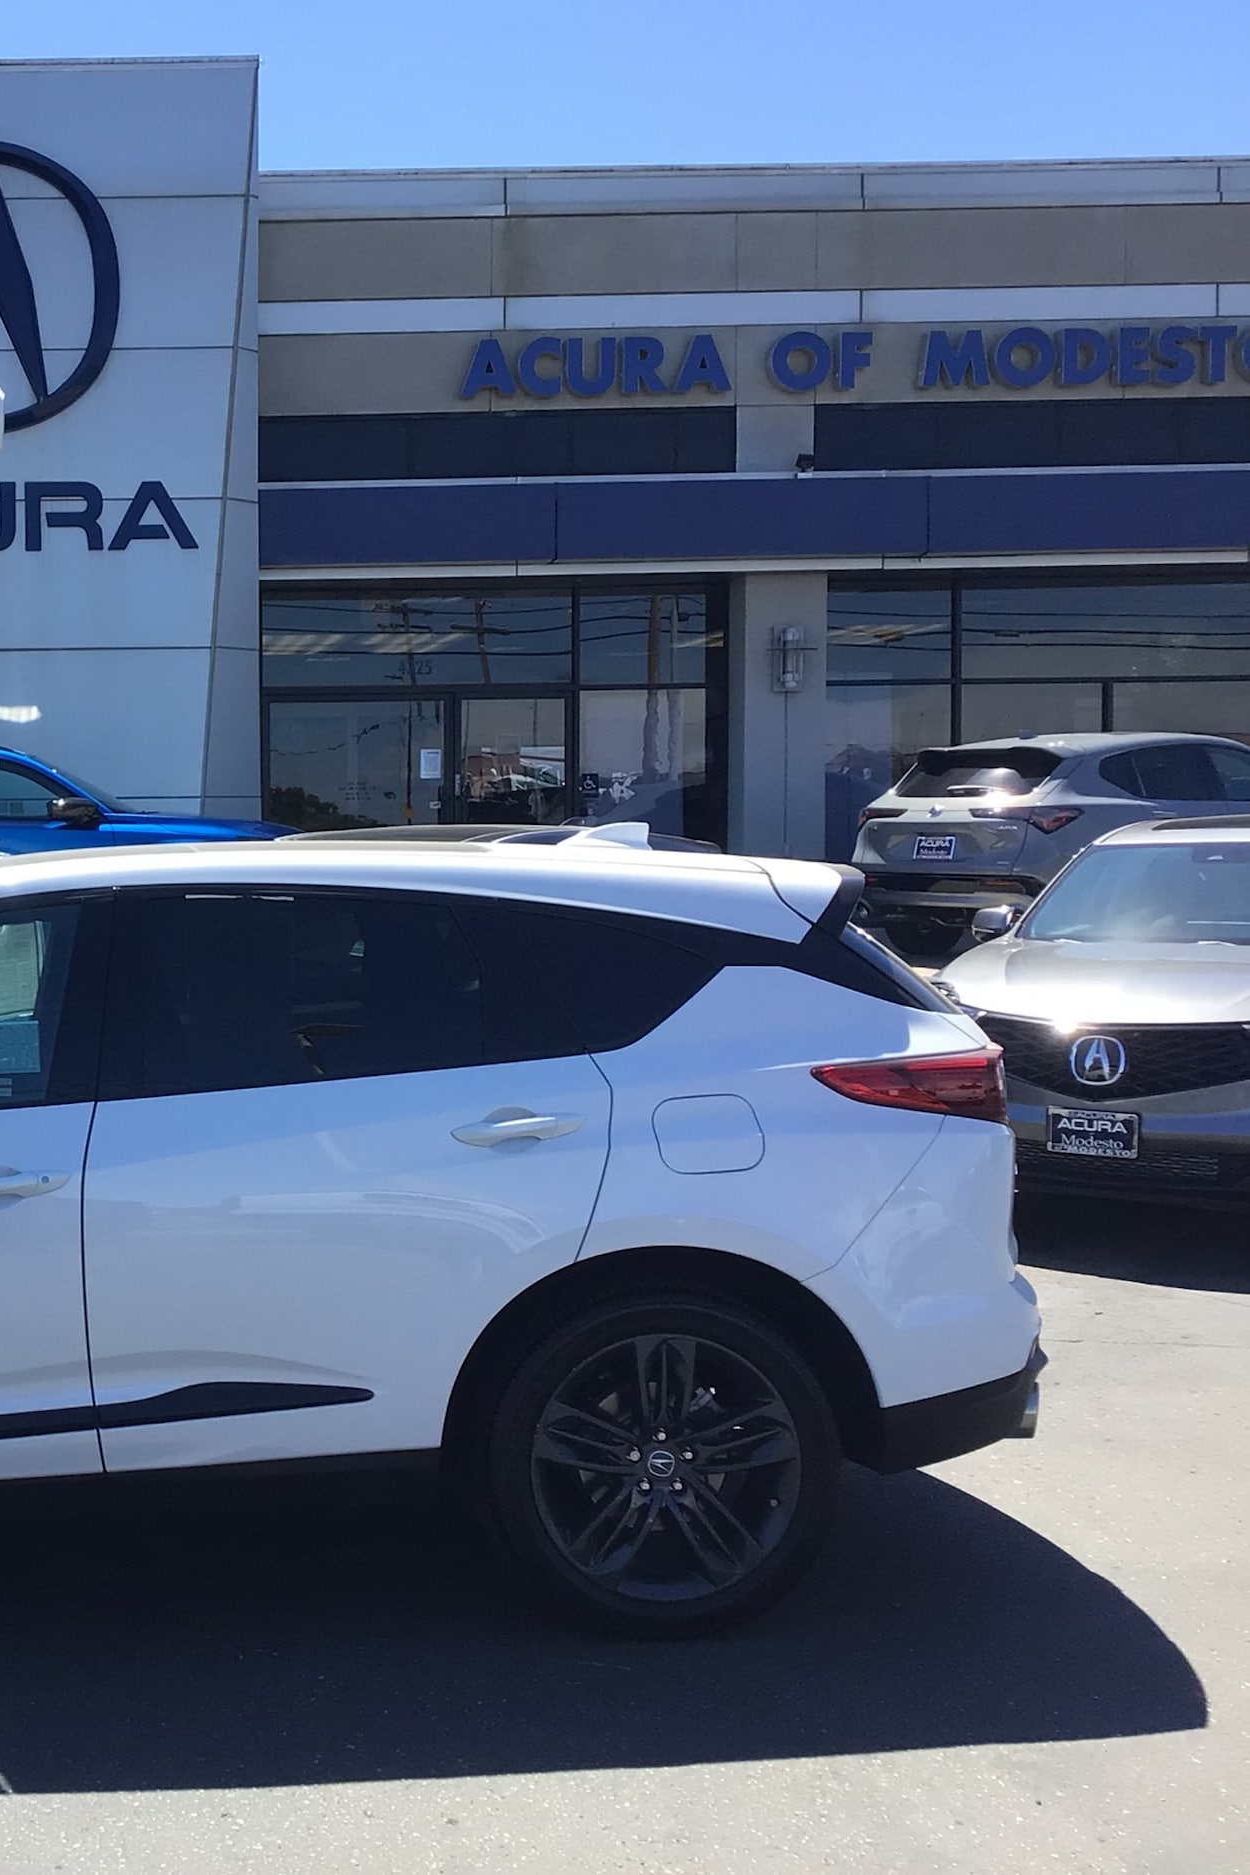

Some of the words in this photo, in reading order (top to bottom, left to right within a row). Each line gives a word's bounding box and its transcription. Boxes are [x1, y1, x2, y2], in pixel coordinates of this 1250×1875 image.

[461, 332, 732, 397] ACURA
[771, 331, 873, 392] OF
[921, 325, 1250, 387] MODEST
[1057, 1118, 1127, 1134] ACURA
[1061, 1133, 1124, 1149] Modesto
